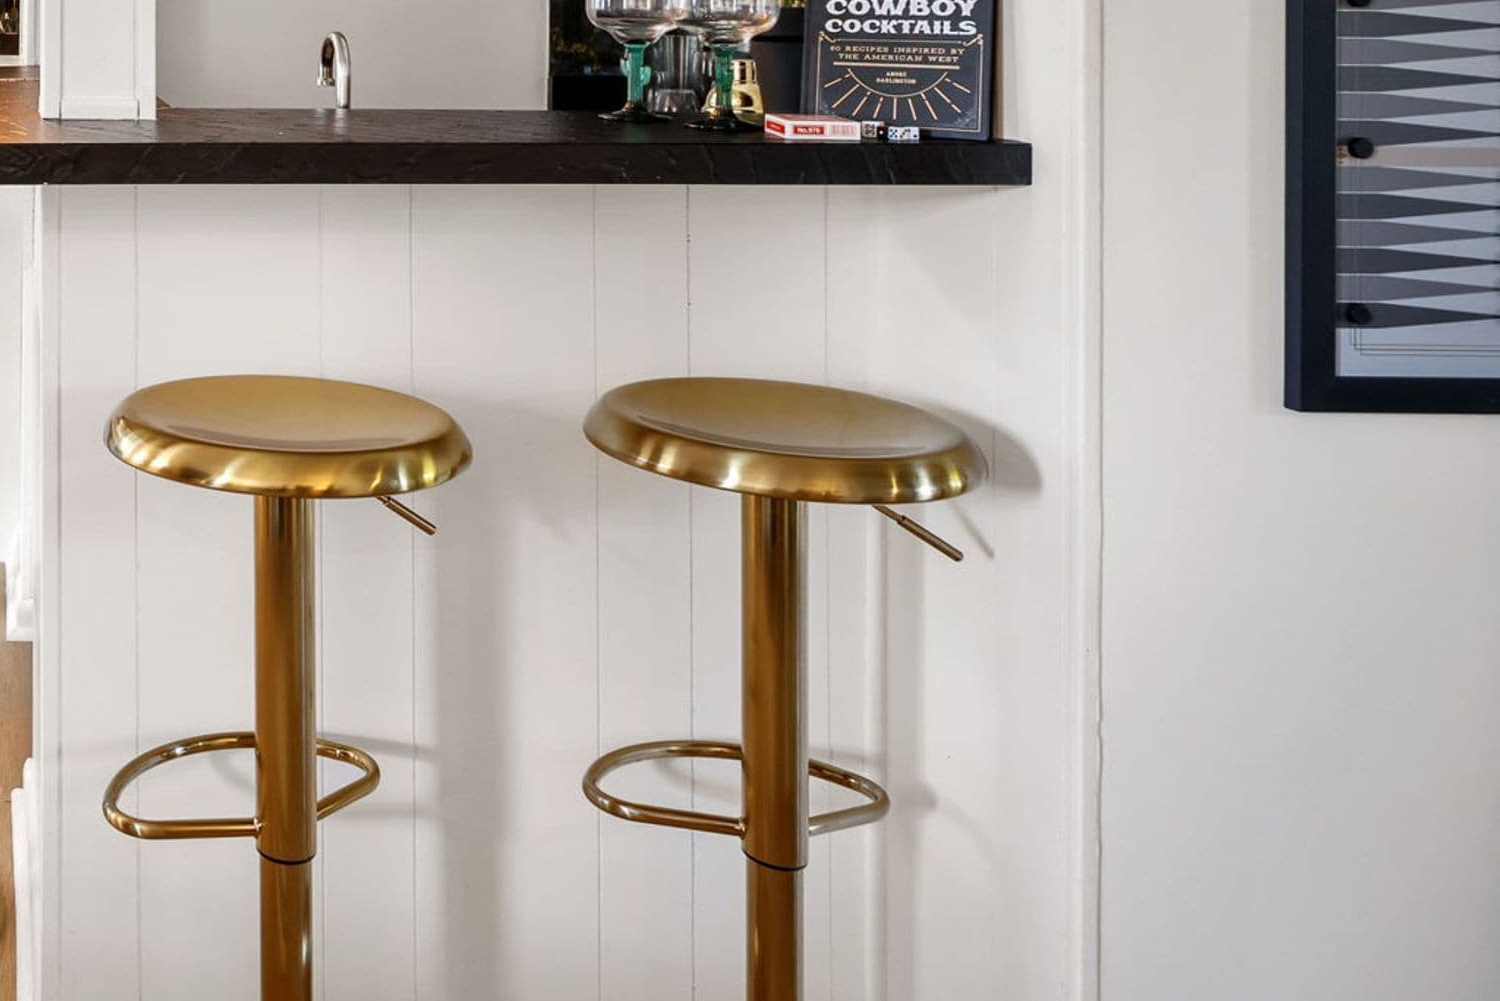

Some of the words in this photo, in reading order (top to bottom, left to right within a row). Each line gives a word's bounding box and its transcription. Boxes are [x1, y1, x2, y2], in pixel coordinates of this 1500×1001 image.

[824, 18, 978, 36] COCKTAILS
[845, 45, 888, 53] RECIPES
[893, 46, 946, 55] INSPIRED
[950, 47, 965, 55] BY
[864, 54, 923, 62] AMERICAN
